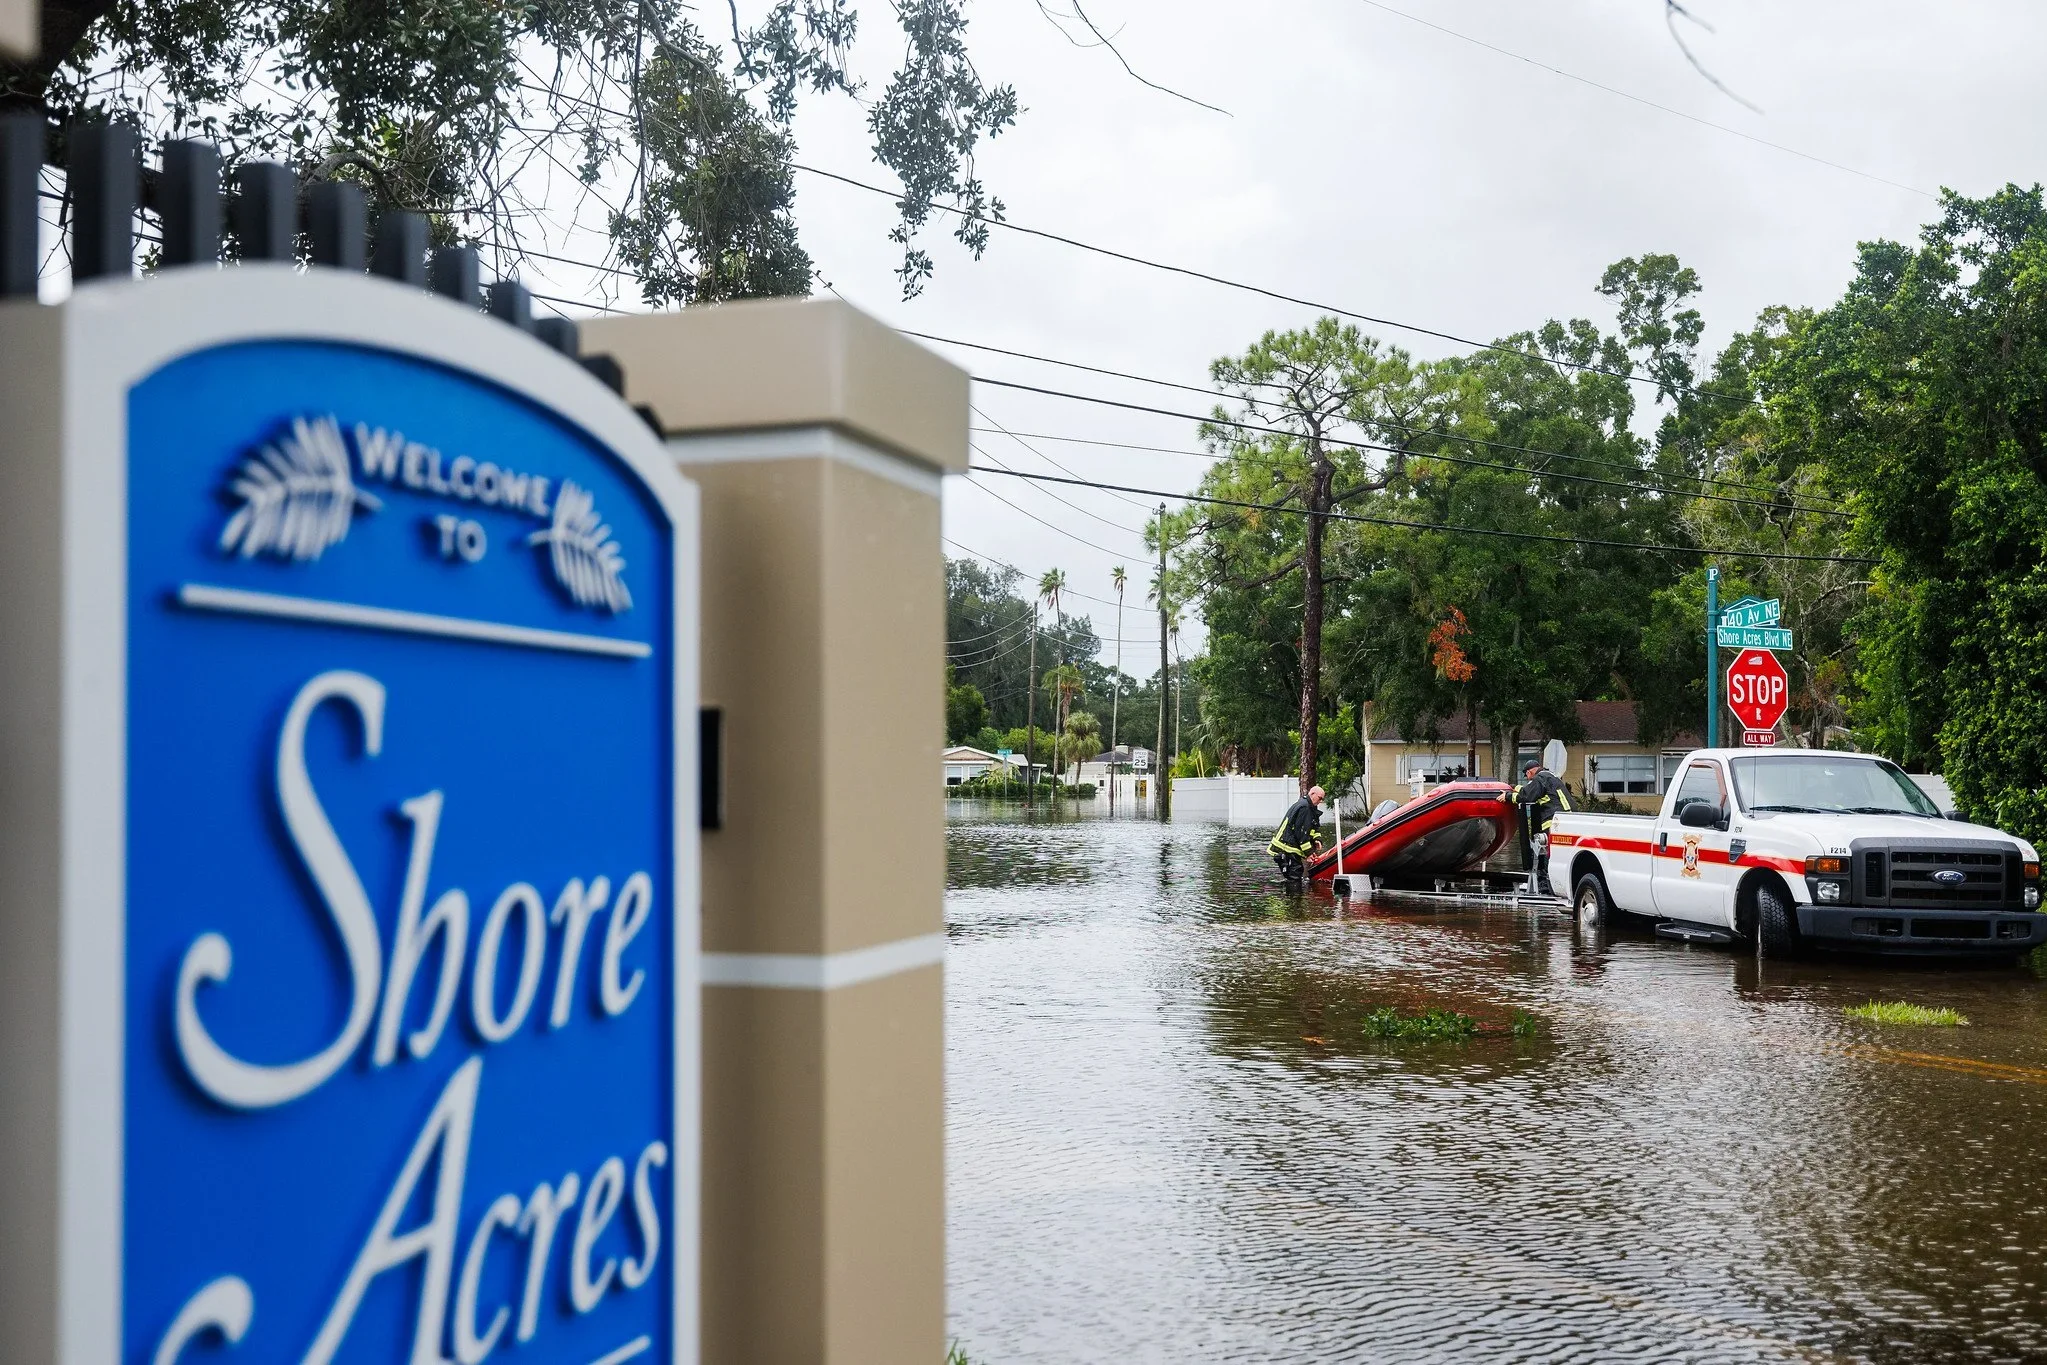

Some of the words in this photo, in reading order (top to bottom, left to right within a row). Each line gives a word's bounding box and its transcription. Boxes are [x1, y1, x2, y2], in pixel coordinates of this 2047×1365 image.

[355, 420, 553, 517] WELCOME
[435, 513, 488, 562] TO
[1728, 612, 1743, 627] 40
[1748, 609, 1760, 624] Av
[1765, 602, 1778, 619] NE
[1719, 629, 1740, 644] Shore
[1743, 630, 1762, 646] Acres
[1764, 631, 1780, 646] Blvd
[1782, 632, 1792, 647] NE
[1732, 673, 1784, 705] STOP
[1747, 734, 1758, 743] ALL
[1760, 735, 1772, 744] WAY
[176, 668, 653, 1109] Shore
[153, 1056, 668, 1365] Acres
